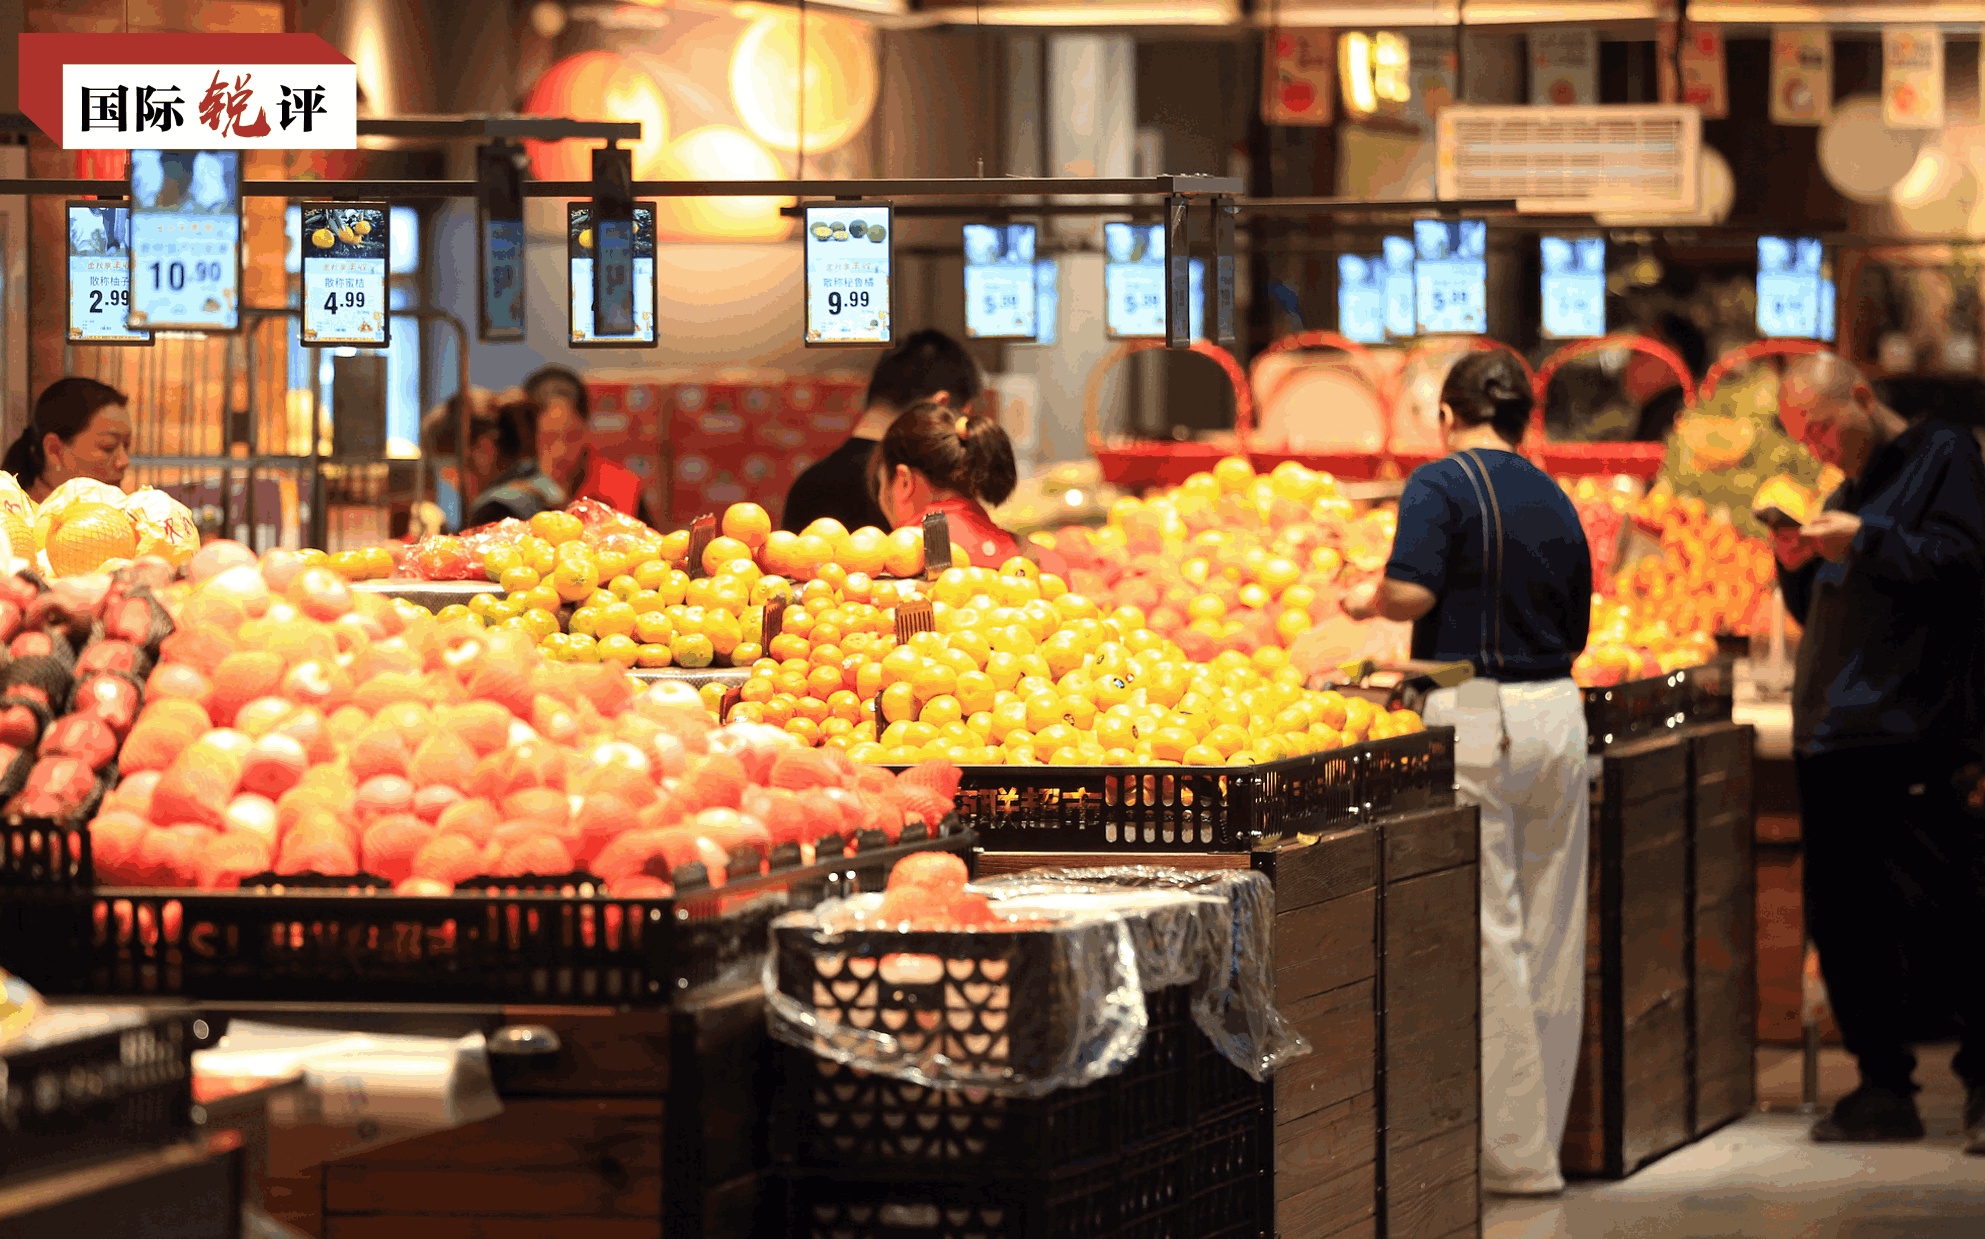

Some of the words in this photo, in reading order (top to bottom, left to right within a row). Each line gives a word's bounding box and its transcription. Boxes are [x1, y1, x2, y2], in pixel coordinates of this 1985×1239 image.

[90, 276, 130, 287] 散称柚子
[89, 289, 130, 314] 2.99
[323, 291, 365, 315] 4.99
[828, 291, 870, 316] 9.99
